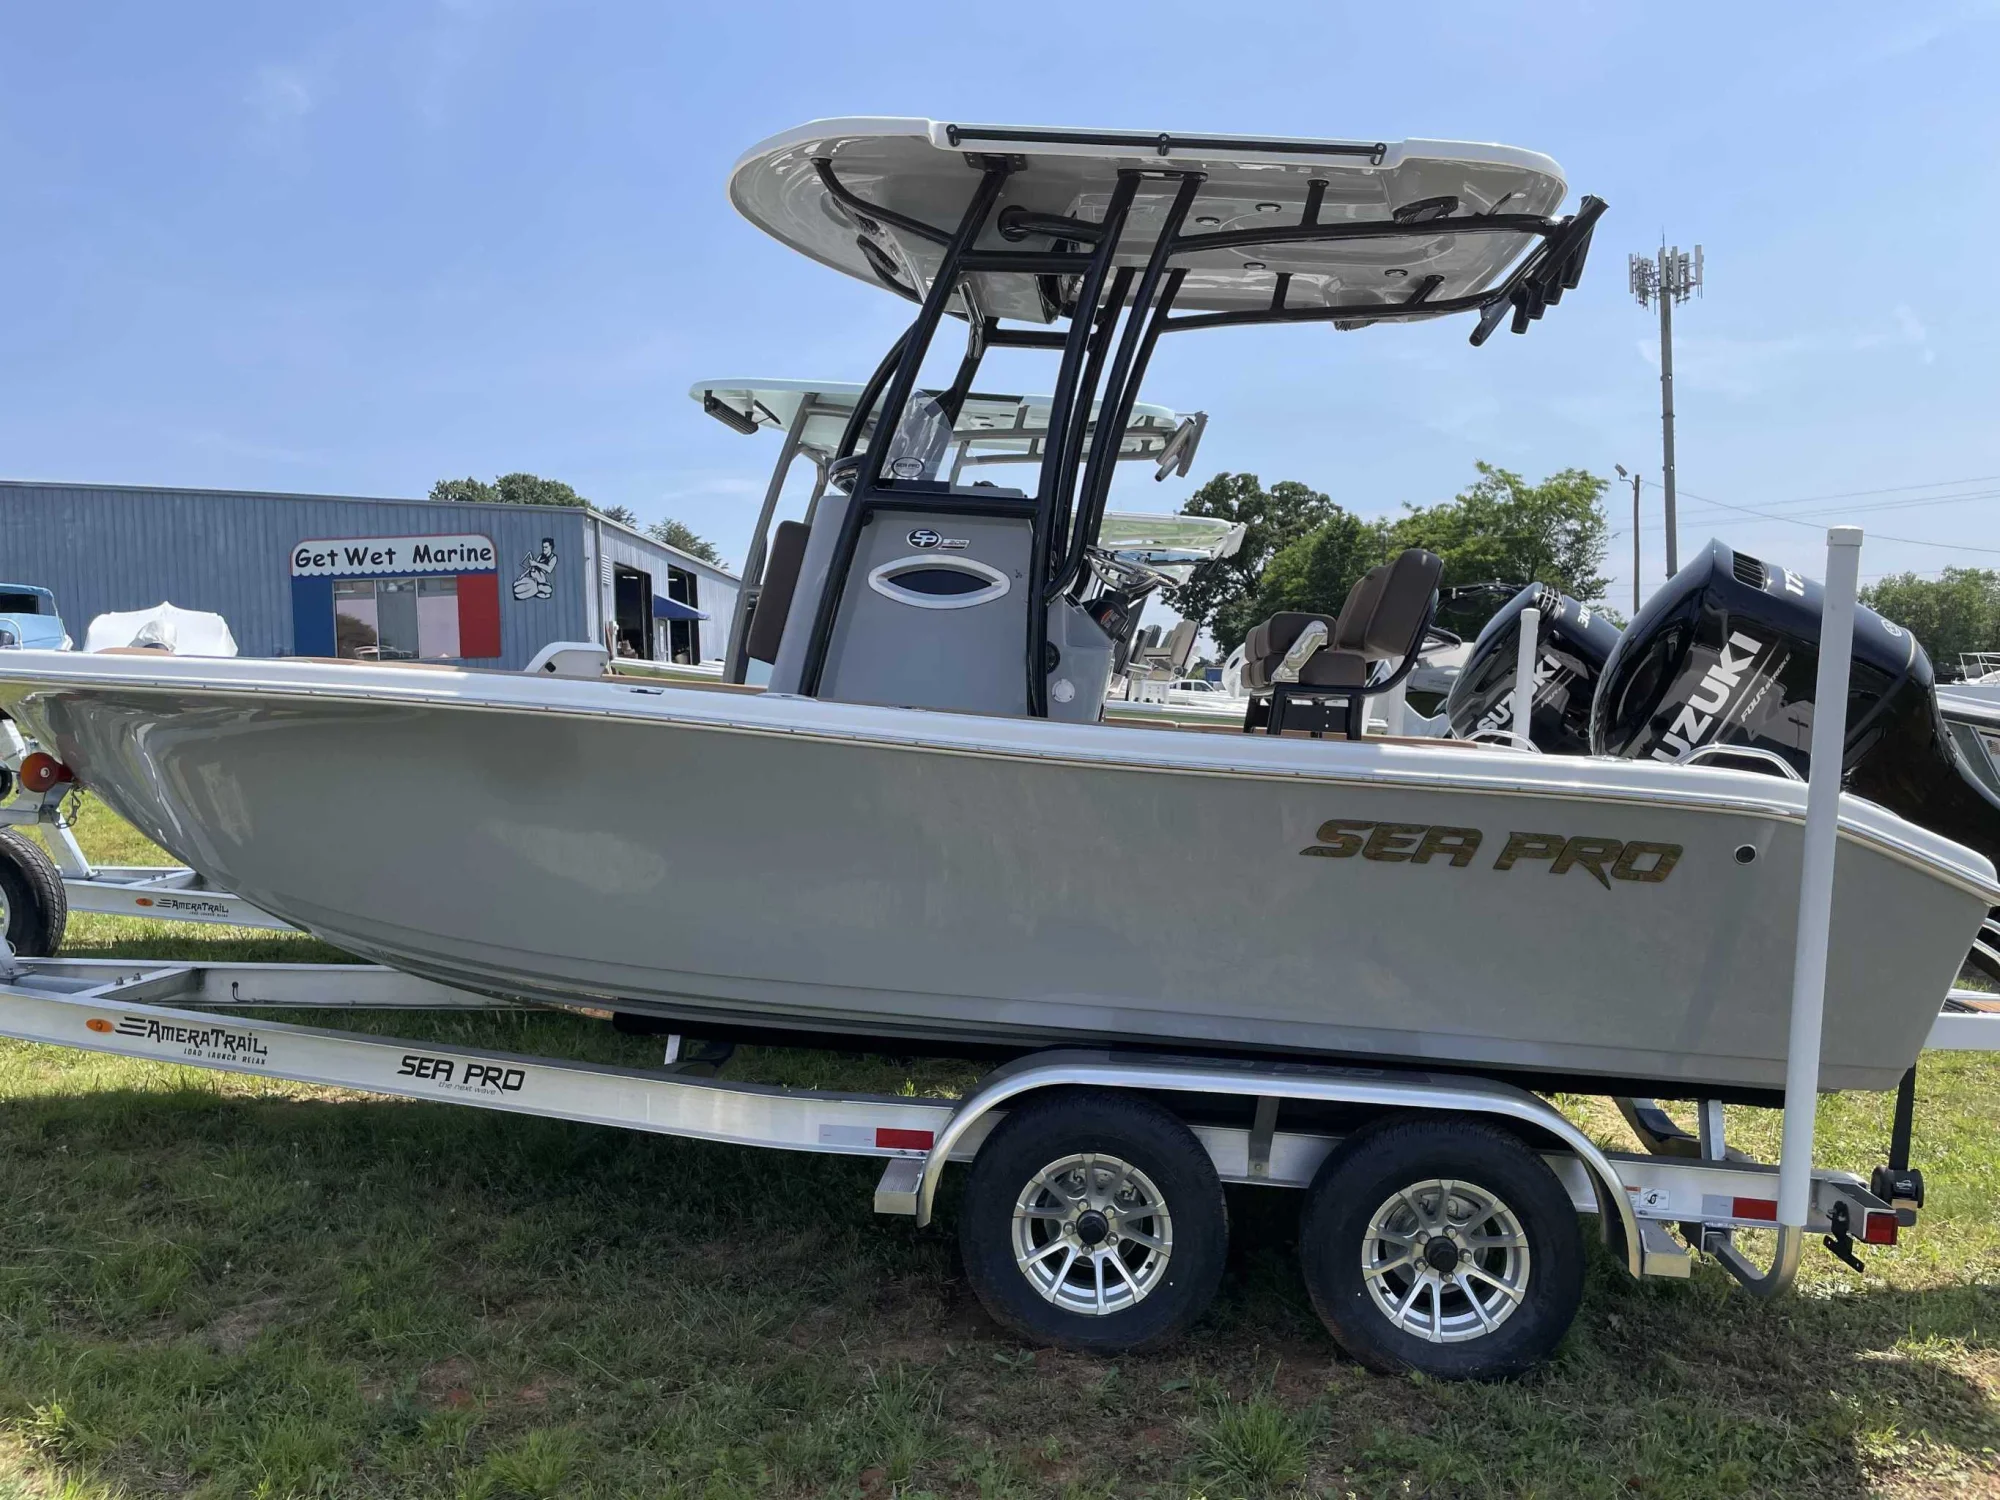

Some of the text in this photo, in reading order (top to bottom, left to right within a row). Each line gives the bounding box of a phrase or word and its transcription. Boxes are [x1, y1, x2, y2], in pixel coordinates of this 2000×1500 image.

[295, 543, 492, 568] Get Wet Marine
[1476, 653, 1562, 732] SUZKI
[1651, 631, 1763, 763] UZUKI
[1300, 819, 1684, 891] SEA PRO
[184, 1047, 266, 1065] LOAD LAUNCH RELAX
[397, 1055, 526, 1095] SEA PRO
[454, 1084, 472, 1092] next
[474, 1087, 497, 1096] wave
